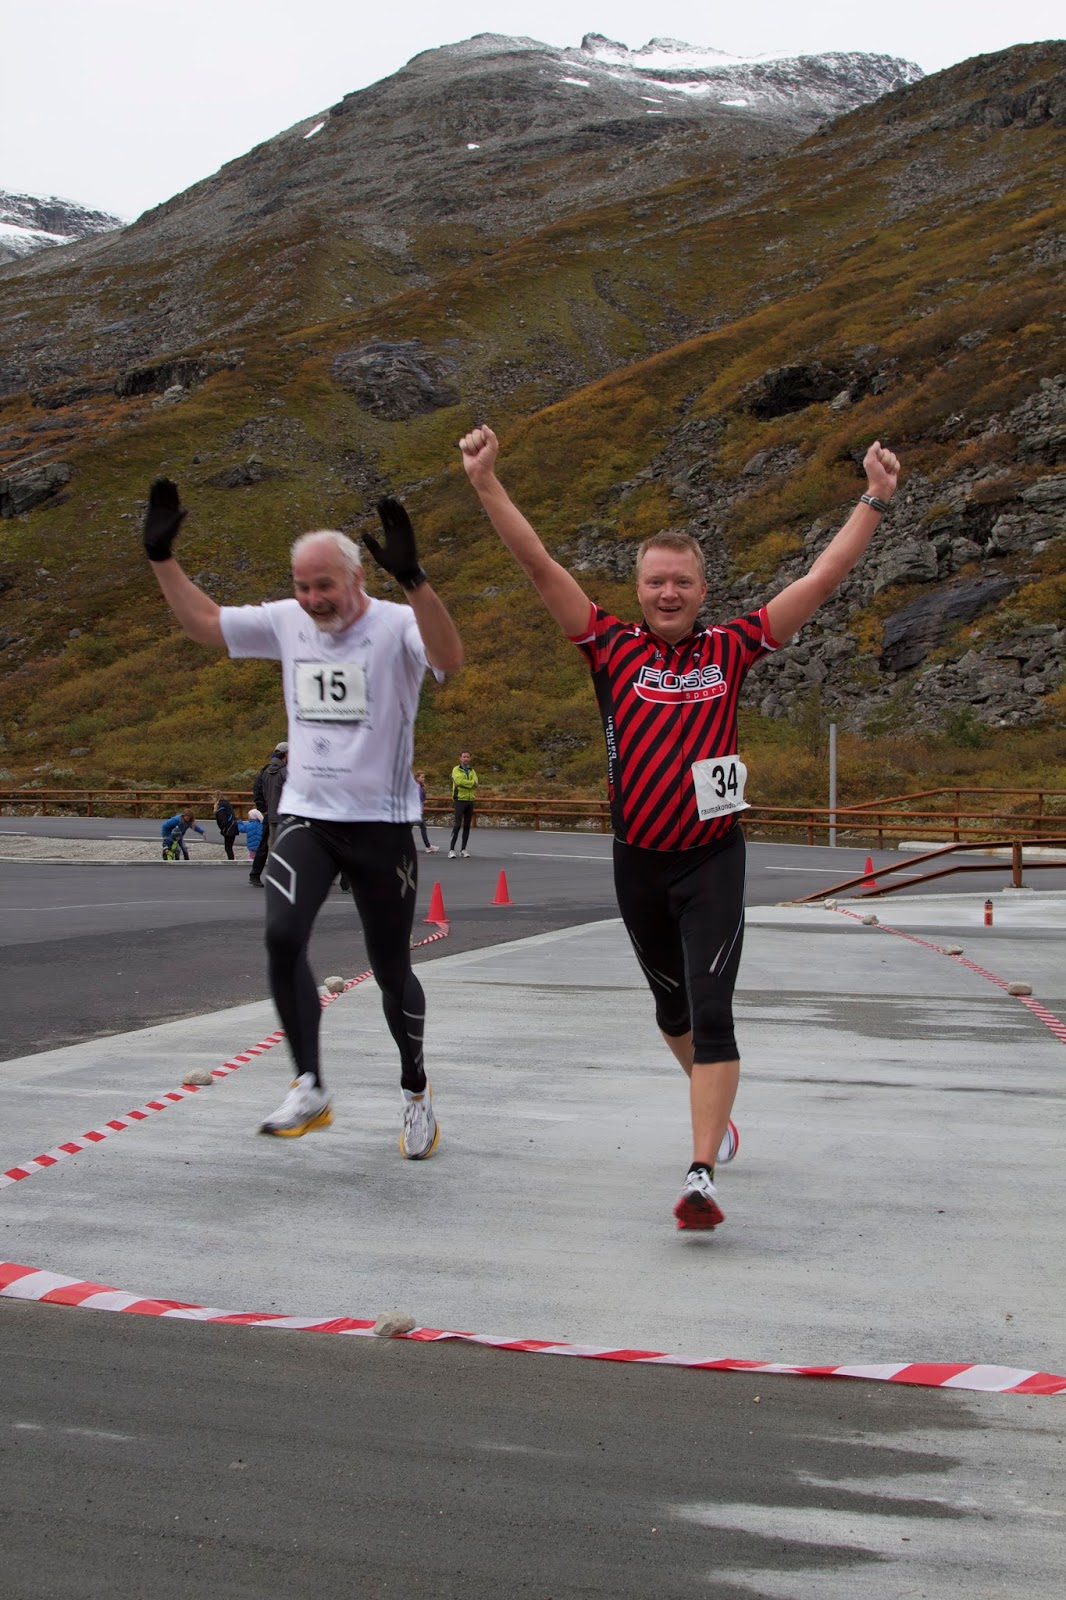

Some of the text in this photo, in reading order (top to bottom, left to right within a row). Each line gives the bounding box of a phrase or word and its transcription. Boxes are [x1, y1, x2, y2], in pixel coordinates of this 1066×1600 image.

[312, 670, 347, 702] 15
[638, 664, 723, 691] FOSS
[685, 685, 724, 700] sport
[606, 715, 618, 759] banken
[712, 762, 738, 798] 34
